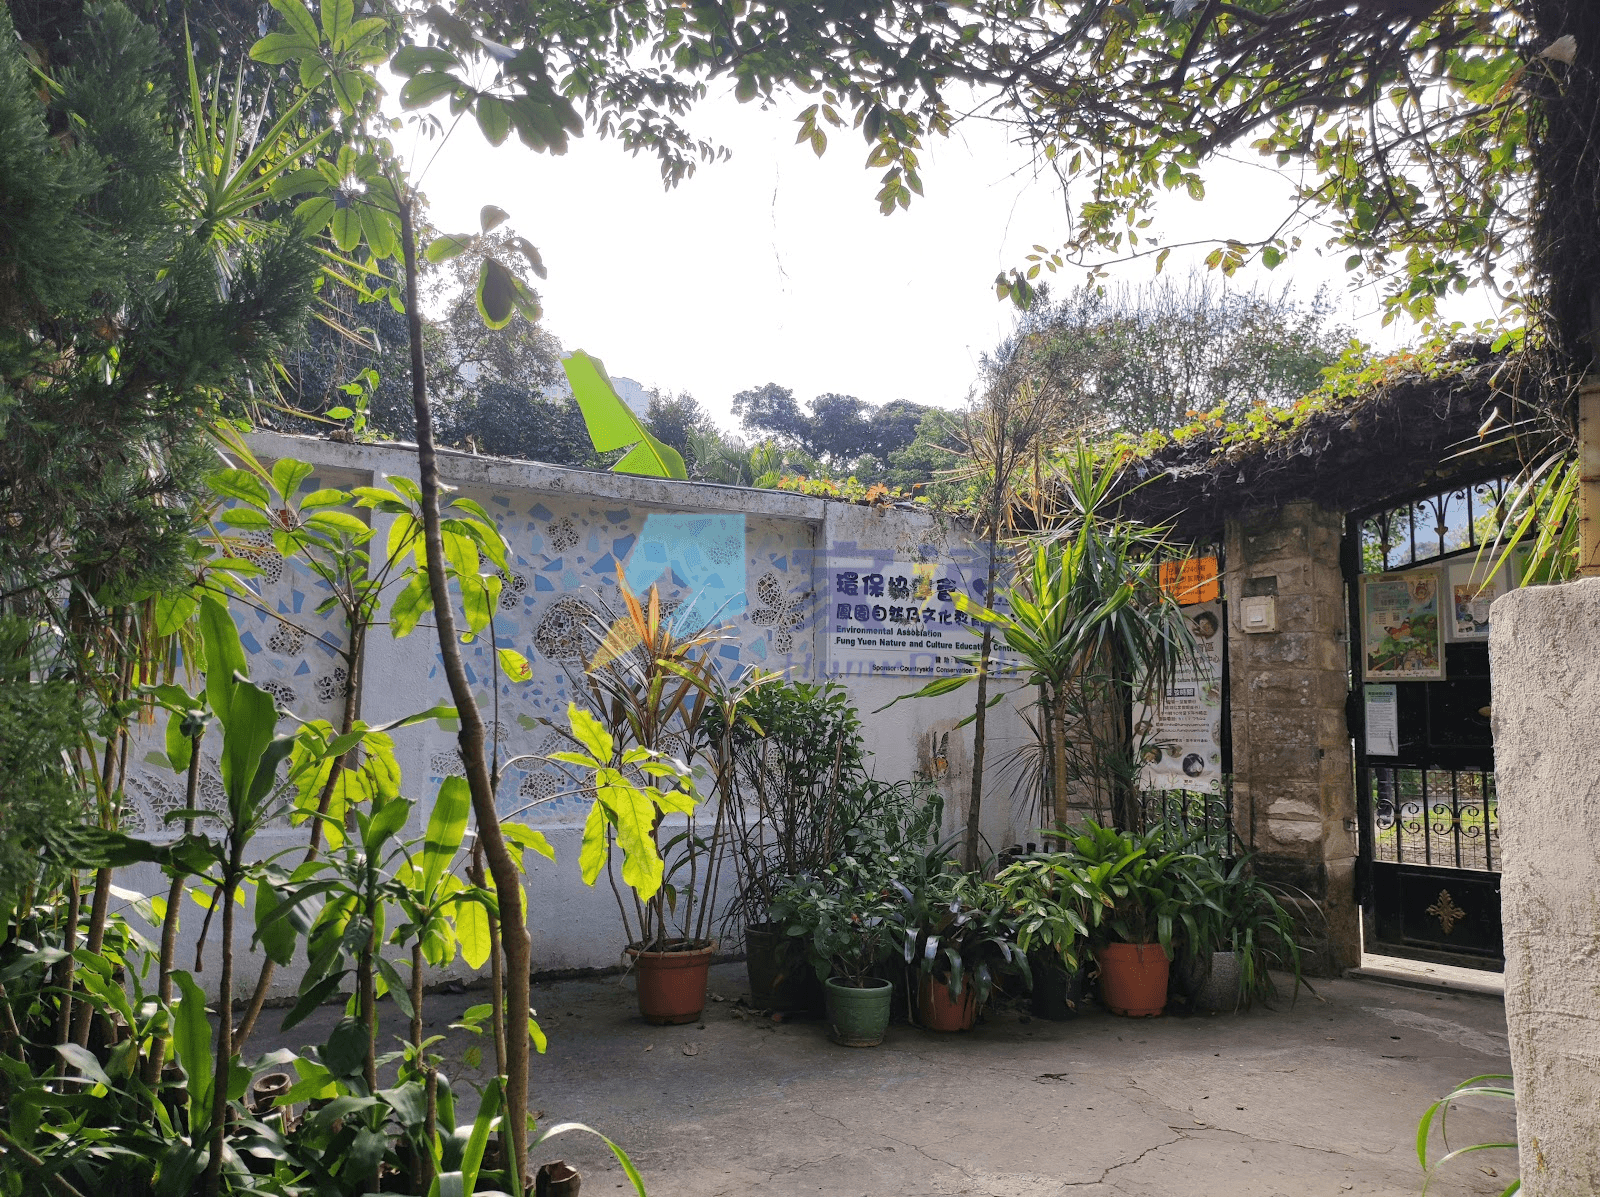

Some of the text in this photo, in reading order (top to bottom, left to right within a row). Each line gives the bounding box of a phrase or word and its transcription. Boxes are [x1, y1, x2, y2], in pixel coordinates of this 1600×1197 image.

[836, 572, 956, 602] 環保協會
[837, 604, 1018, 628] 鳳園自然及文化教
[836, 625, 942, 638] Environmental Association
[836, 636, 856, 647] Fung
[857, 637, 877, 646] Yuen
[879, 638, 906, 647] Nature
[909, 640, 924, 648] and
[926, 640, 953, 649] Culture
[955, 641, 991, 652] Educati
[900, 665, 934, 674] Countryside
[936, 666, 973, 674] Conservation
